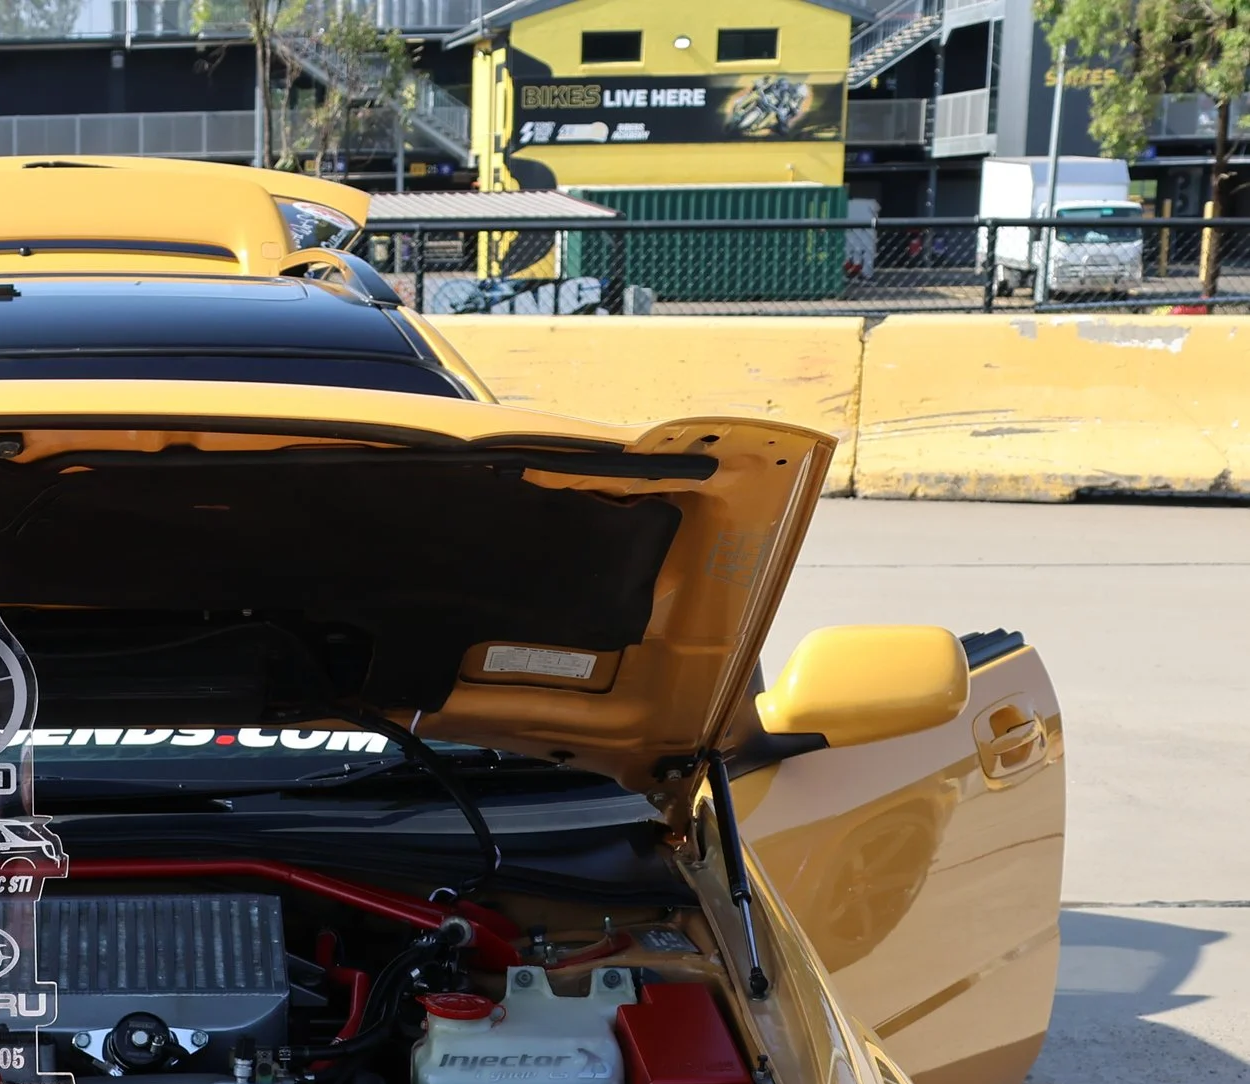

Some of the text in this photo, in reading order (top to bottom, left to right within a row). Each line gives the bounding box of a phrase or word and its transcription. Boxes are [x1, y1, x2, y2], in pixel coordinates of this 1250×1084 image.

[521, 85, 706, 109] BIKES LIVE HERE
[8, 875, 33, 893] STI
[438, 1053, 572, 1072] Injector
